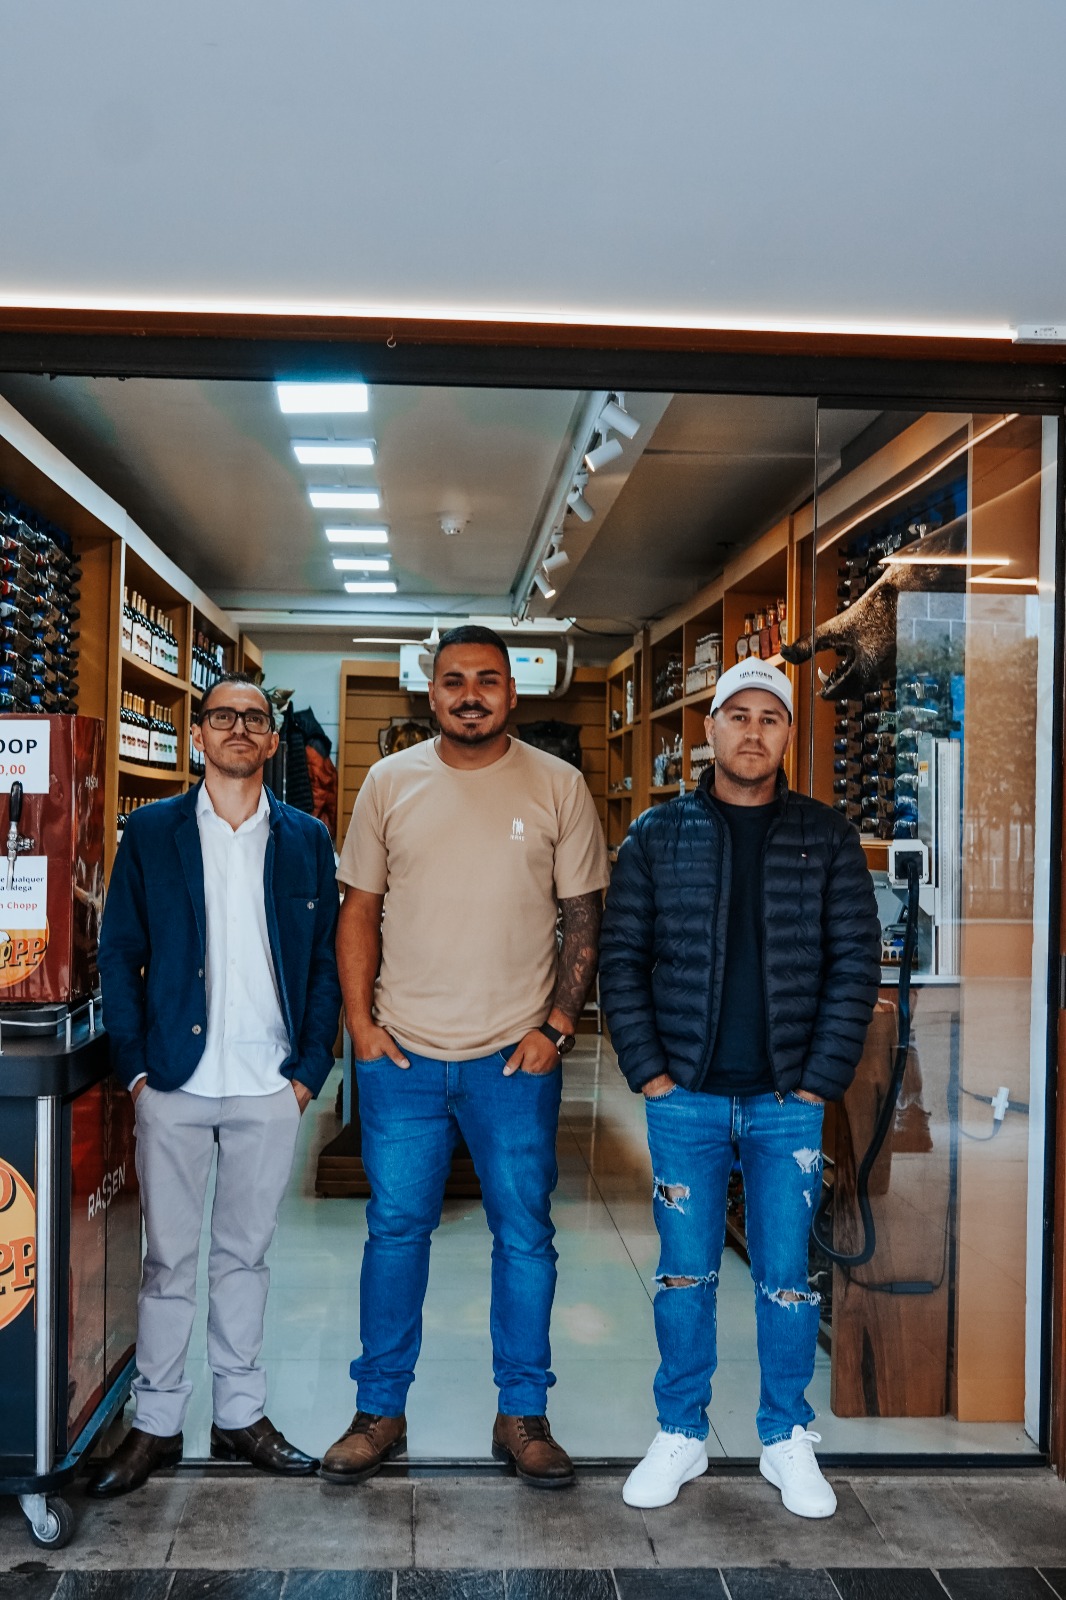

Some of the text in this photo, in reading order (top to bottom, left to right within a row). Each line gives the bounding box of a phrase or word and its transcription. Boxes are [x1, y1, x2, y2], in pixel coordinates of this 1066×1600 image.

[12, 876, 44, 884] ualquer
[7, 902, 38, 910] Chopp
[87, 1161, 126, 1222] RASEN
